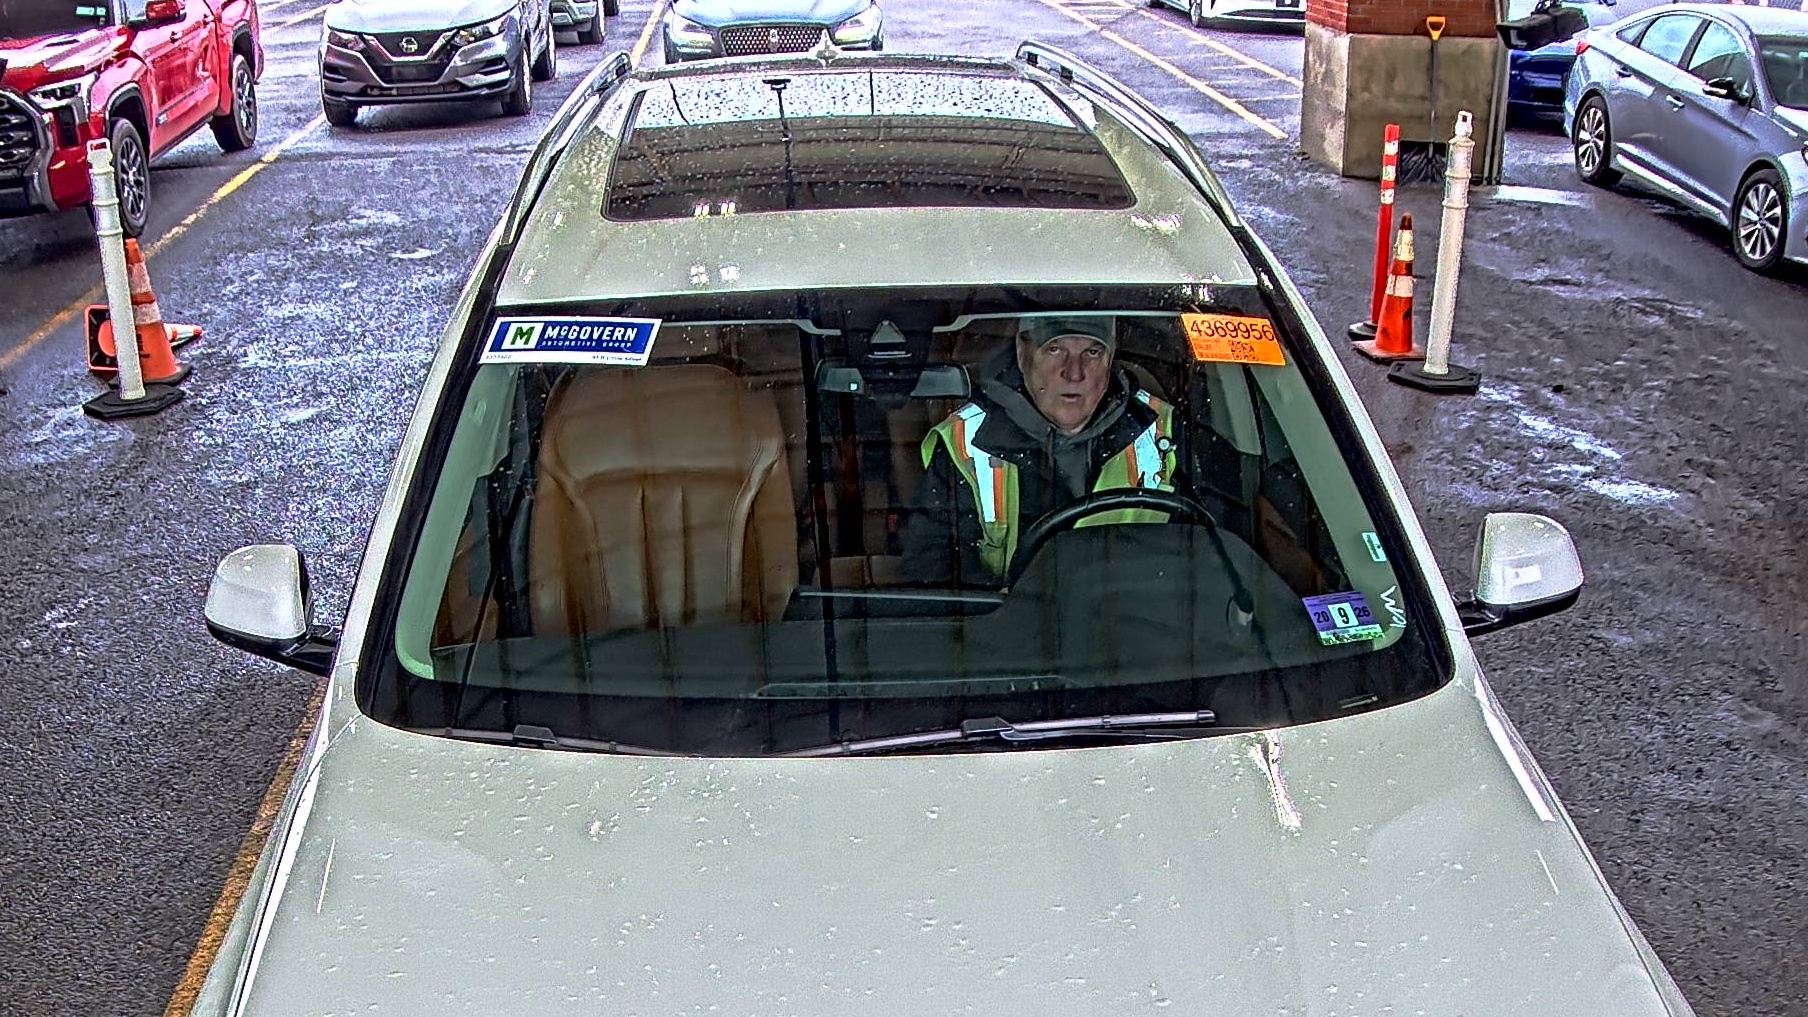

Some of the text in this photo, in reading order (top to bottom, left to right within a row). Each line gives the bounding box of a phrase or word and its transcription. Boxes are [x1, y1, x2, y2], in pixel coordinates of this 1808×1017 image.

[510, 325, 535, 346] M
[1190, 319, 1275, 342] 4369956
[1314, 606, 1371, 625] 20 9 26
